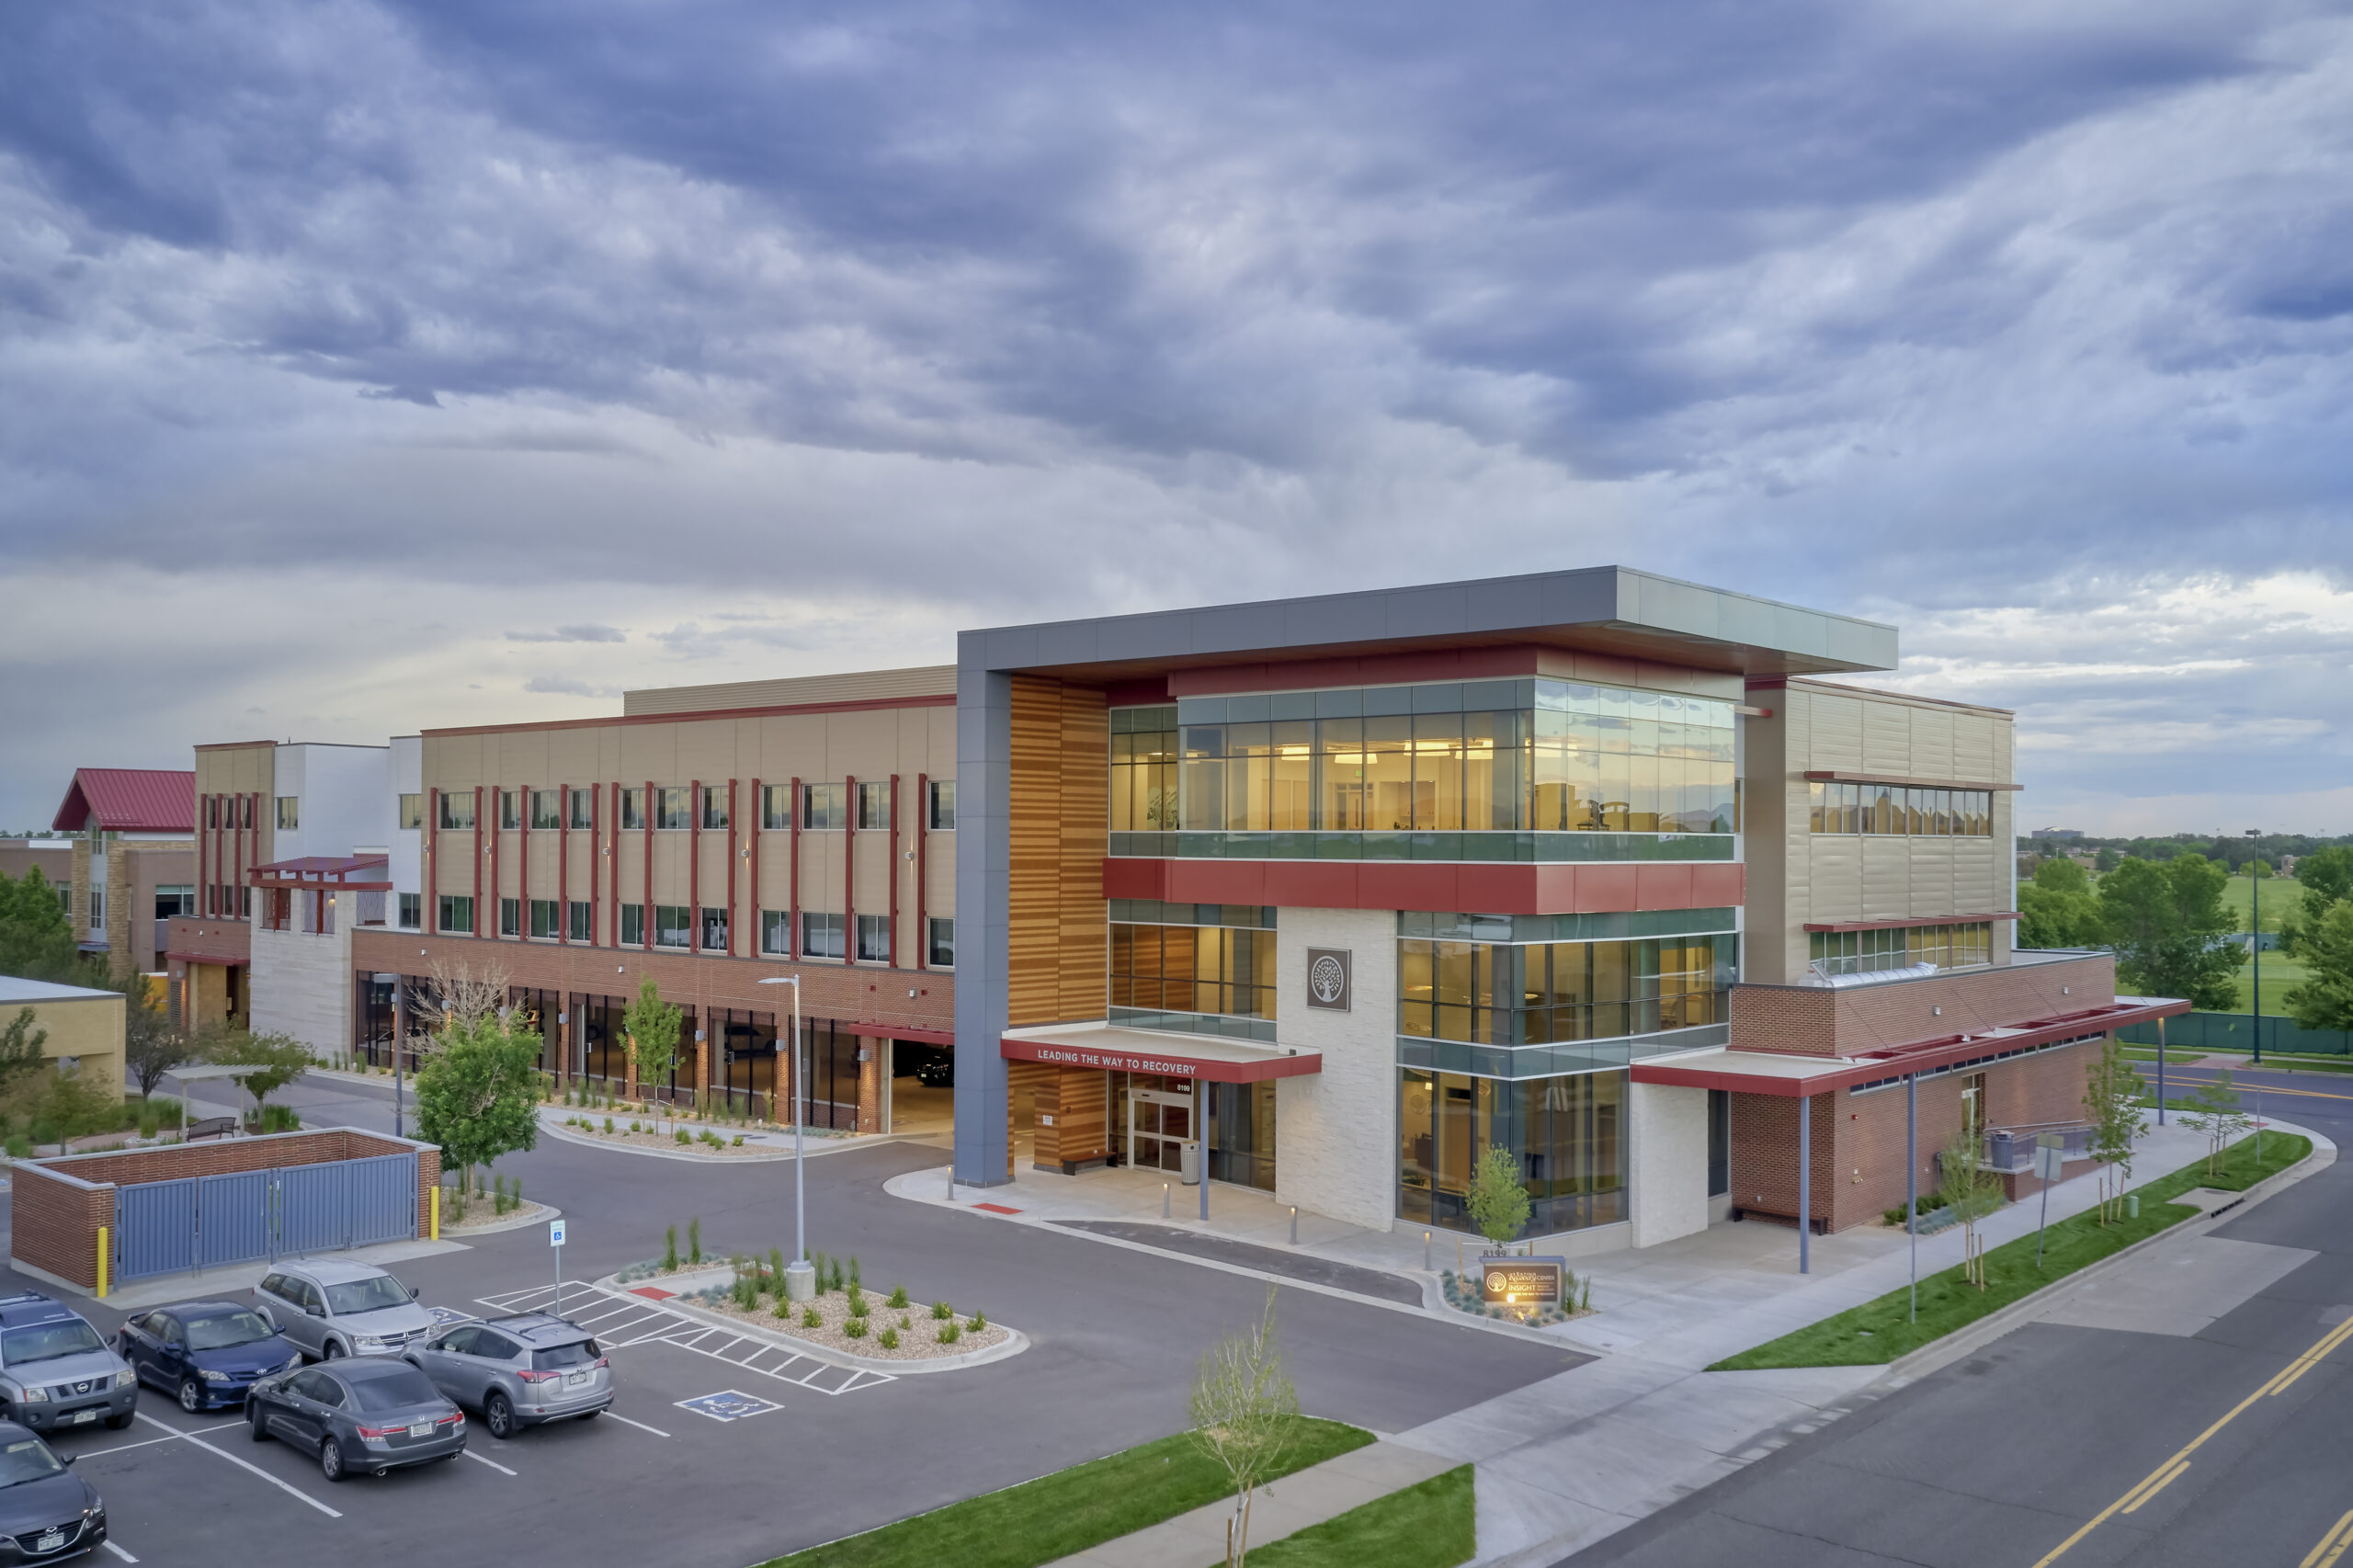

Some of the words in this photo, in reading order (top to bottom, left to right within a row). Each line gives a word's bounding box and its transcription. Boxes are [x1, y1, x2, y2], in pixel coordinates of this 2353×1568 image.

[1038, 1050, 1078, 1062] LEADING
[1081, 1054, 1099, 1065] THE
[1102, 1056, 1123, 1067] WAY
[1126, 1059, 1140, 1069] TO
[1142, 1061, 1196, 1074] RECOVERY
[1176, 1084, 1190, 1092] 8199
